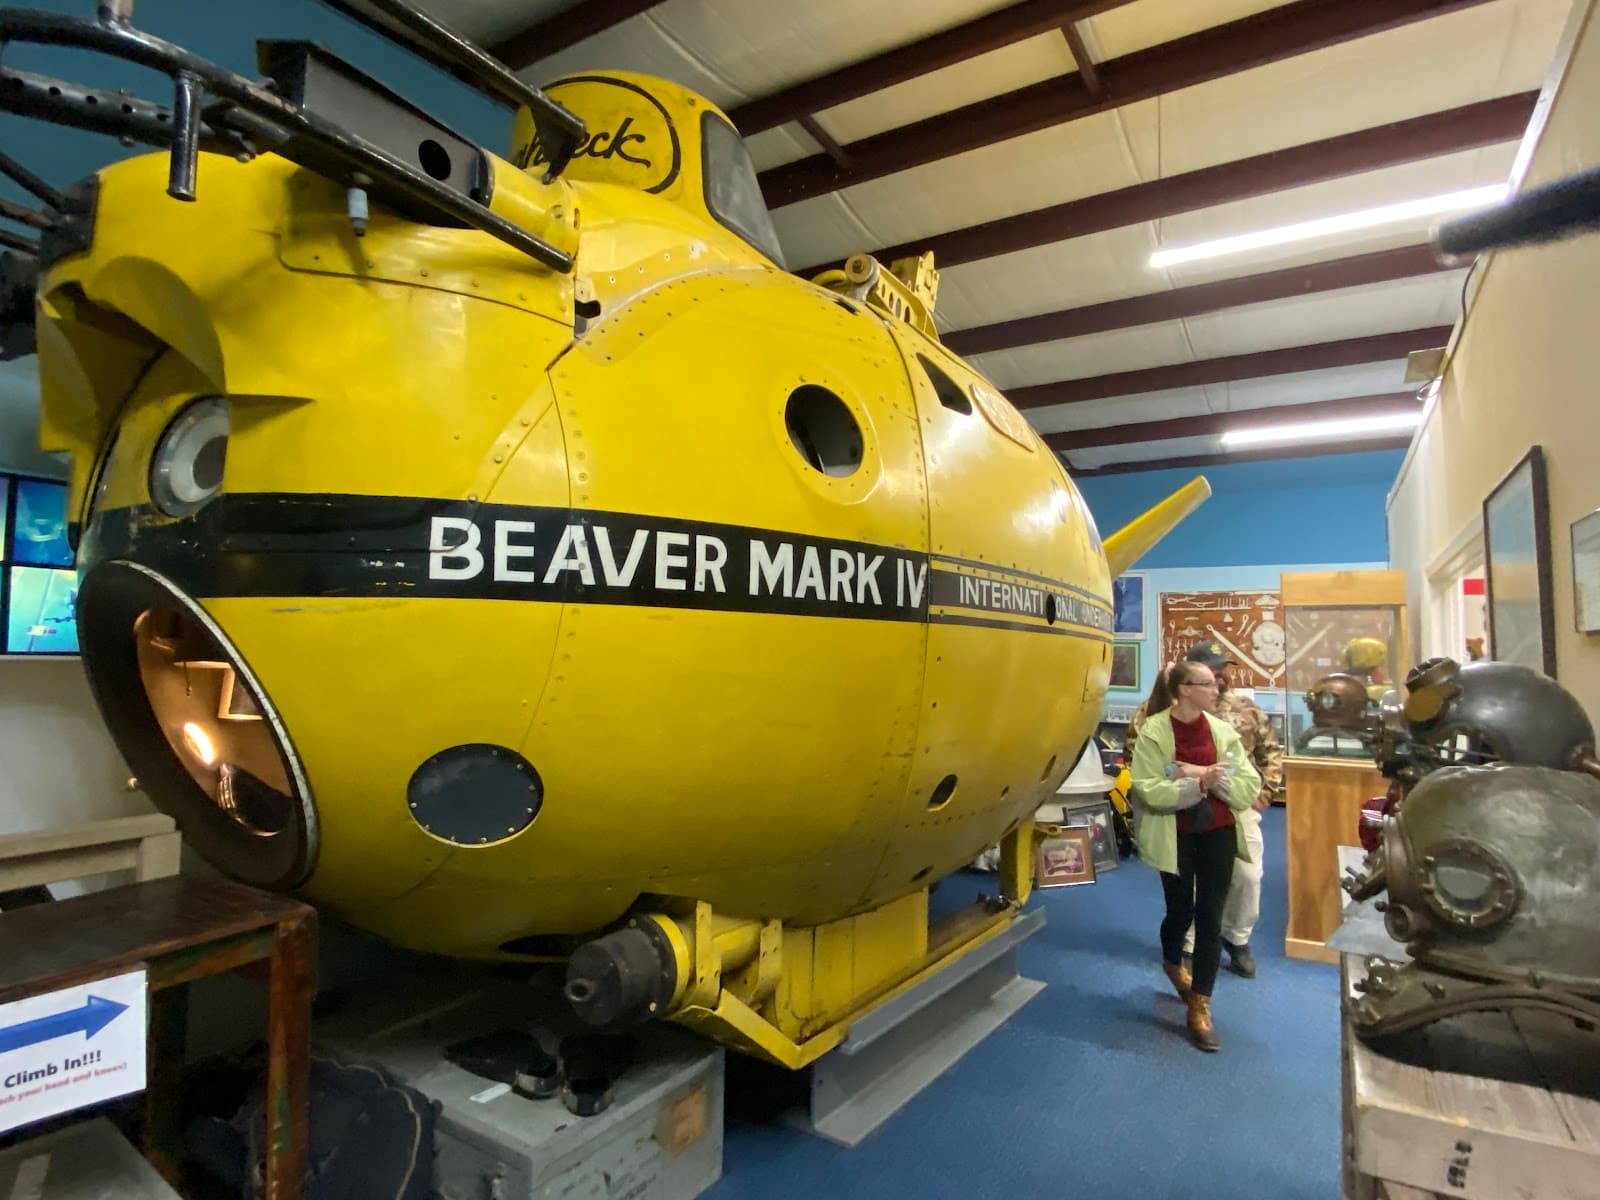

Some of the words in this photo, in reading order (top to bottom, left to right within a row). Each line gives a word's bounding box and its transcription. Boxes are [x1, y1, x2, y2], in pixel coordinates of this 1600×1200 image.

[428, 516, 728, 593] BEAVER
[748, 539, 885, 605] MARK
[896, 557, 927, 609] IV
[4, 1063, 58, 1089] Climb
[64, 1050, 102, 1071] In!!!
[18, 1086, 42, 1101] your
[73, 1072, 91, 1083] and
